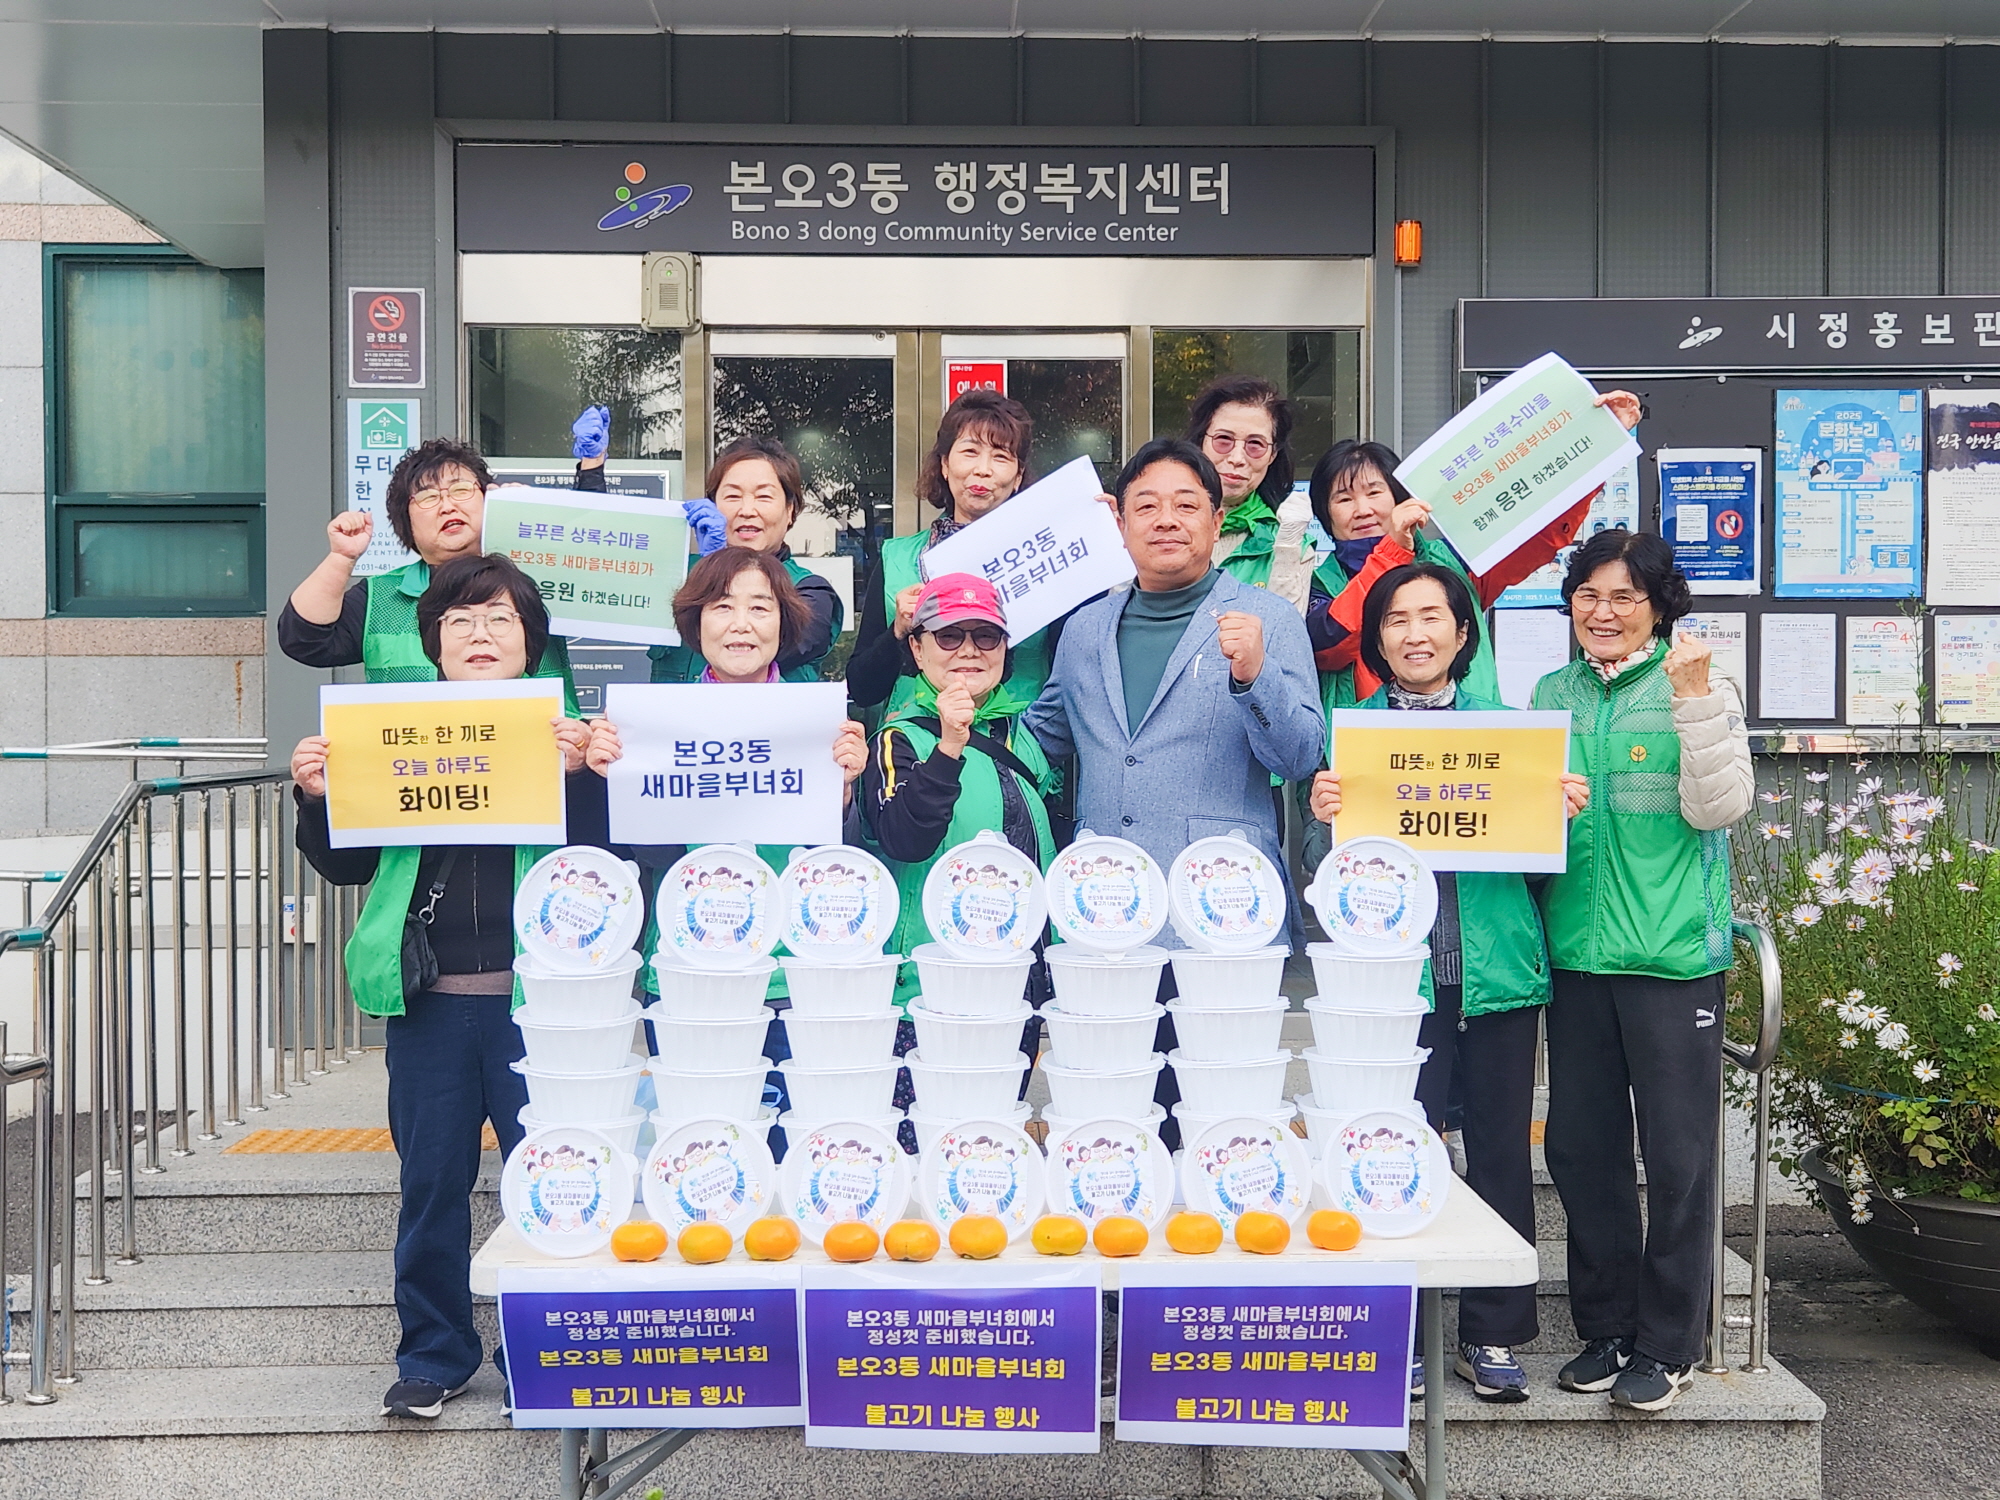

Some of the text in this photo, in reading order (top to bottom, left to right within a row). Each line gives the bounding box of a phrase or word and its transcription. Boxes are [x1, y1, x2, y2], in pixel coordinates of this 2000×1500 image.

[723, 161, 1230, 216] 본오3동 행정복지센터
[732, 220, 1179, 246] Bono 3 dong Community Service Center
[1836, 411, 1862, 421] 2025
[1439, 392, 1552, 482] 늘푸른 상록수마을
[1818, 421, 1879, 438] 문화누리
[1833, 438, 1864, 454] 카드
[1936, 433, 1962, 450] 전국
[1451, 408, 1574, 506] 본오3동 새마을부녀회가
[1472, 435, 1594, 532] 함께 응원 하겠습니다!
[518, 522, 650, 550] 늘푸른 상록수마을
[509, 549, 655, 577] 본오3동 새마을부녀회가
[981, 526, 1057, 584] 본오3동
[361, 563, 396, 571] 031-481-
[1000, 537, 1089, 606] 마을부녀회
[538, 580, 651, 609] 응원 하겠습니다!
[382, 724, 497, 746] 따뜻한 한 끼로
[673, 739, 772, 767] 본오3동
[1390, 752, 1501, 771] 따뜻한 한 끼로
[392, 755, 492, 777] 오늘 하루도
[640, 768, 804, 799] 새마을부녀회
[1396, 783, 1492, 802] 오늘 하루도
[398, 784, 490, 813] 화이팅!
[1398, 810, 1488, 838] 화이팅!
[545, 1307, 756, 1327] 본오3동 새마을부녀회에서
[846, 1309, 1055, 1328] 본오3동 새마을부녀회에서
[1163, 1305, 1370, 1323] 본오3동 새마을부녀회에서
[567, 1324, 736, 1341] 정성껏 준비했습니다.
[867, 1329, 1035, 1346] 정성껏 준비했습니다.
[1183, 1324, 1349, 1341] 정성껏 준비했습니다.
[539, 1345, 769, 1367] 본오3동 새마을부녀회
[1150, 1351, 1377, 1373] 본오3동 새마을부녀회
[837, 1357, 1066, 1379] 본오3동 새마을부녀회
[571, 1385, 746, 1407] 불고기 나눔 행사
[865, 1404, 1040, 1429] 불고기 나눔 행사
[1175, 1398, 1350, 1424] 불고기 나눔 행사
